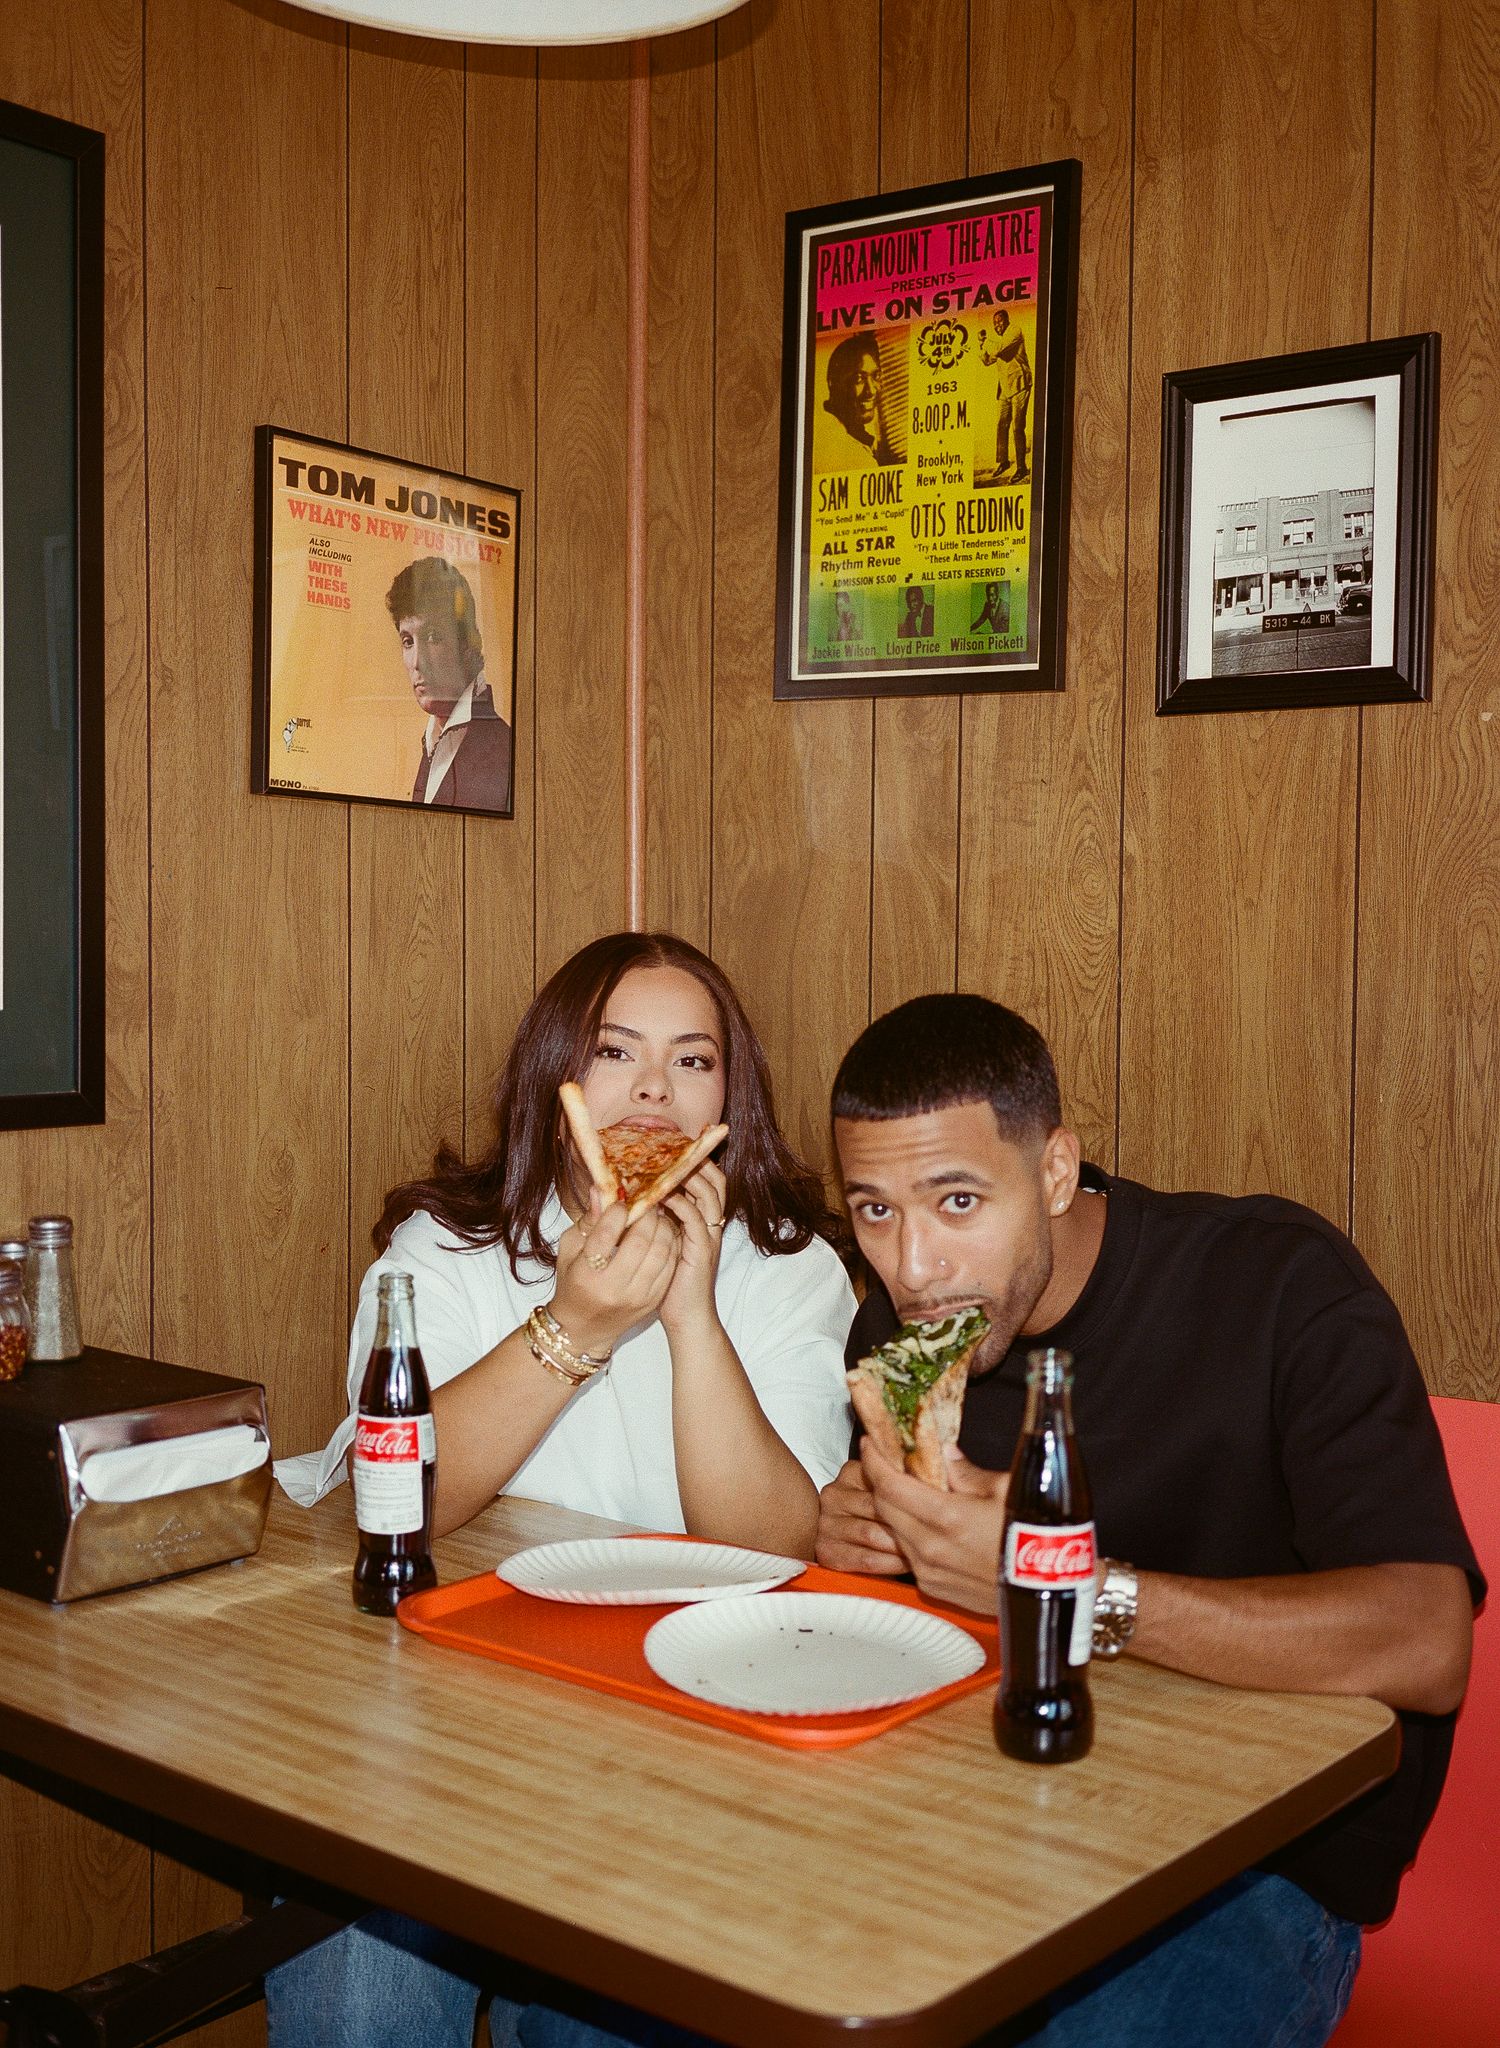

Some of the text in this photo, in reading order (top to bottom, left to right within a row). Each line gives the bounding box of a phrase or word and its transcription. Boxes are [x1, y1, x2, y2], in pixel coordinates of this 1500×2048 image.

[820, 210, 1035, 289] PARAMOUNT THEATRE
[891, 272, 956, 293] PRESENTS
[817, 277, 1032, 332] LIVE ON STAGE
[929, 333, 956, 346] JULY
[932, 346, 952, 358] 4th
[927, 381, 958, 396] 1963
[918, 453, 964, 470] Brooklyn,
[916, 470, 964, 488] New York
[279, 456, 510, 539] TOM JONES
[818, 470, 904, 512] SAM COOKE
[288, 498, 361, 532] WHAT'S
[366, 517, 409, 543] NEW
[836, 515, 852, 524] Send
[873, 512, 878, 520] &
[911, 495, 1024, 539] OTIS REDDING
[853, 526, 888, 534] APPEARING
[309, 537, 330, 548] ALSO
[823, 536, 895, 556] ALL STAR
[940, 542, 958, 550] Little
[1012, 536, 1026, 545] and
[309, 548, 352, 562] INCLUDING
[953, 554, 972, 562] Arms
[976, 552, 988, 560] Are
[308, 560, 342, 577] WITH
[821, 556, 901, 573] Rhythm Revue
[833, 574, 896, 587] ADMISSION $5.00
[922, 567, 1005, 580] ALL SEATS RESERVED
[308, 575, 347, 593] THESE
[307, 591, 350, 610] HANDS
[1265, 617, 1288, 628] 5313
[1320, 614, 1331, 624] BK
[887, 641, 940, 658] Lloyd Price
[950, 636, 1024, 651] Wilson Pickett
[813, 647, 840, 660] Jackie
[270, 778, 301, 788] MONO
[356, 1425, 414, 1455] Coca-Cola
